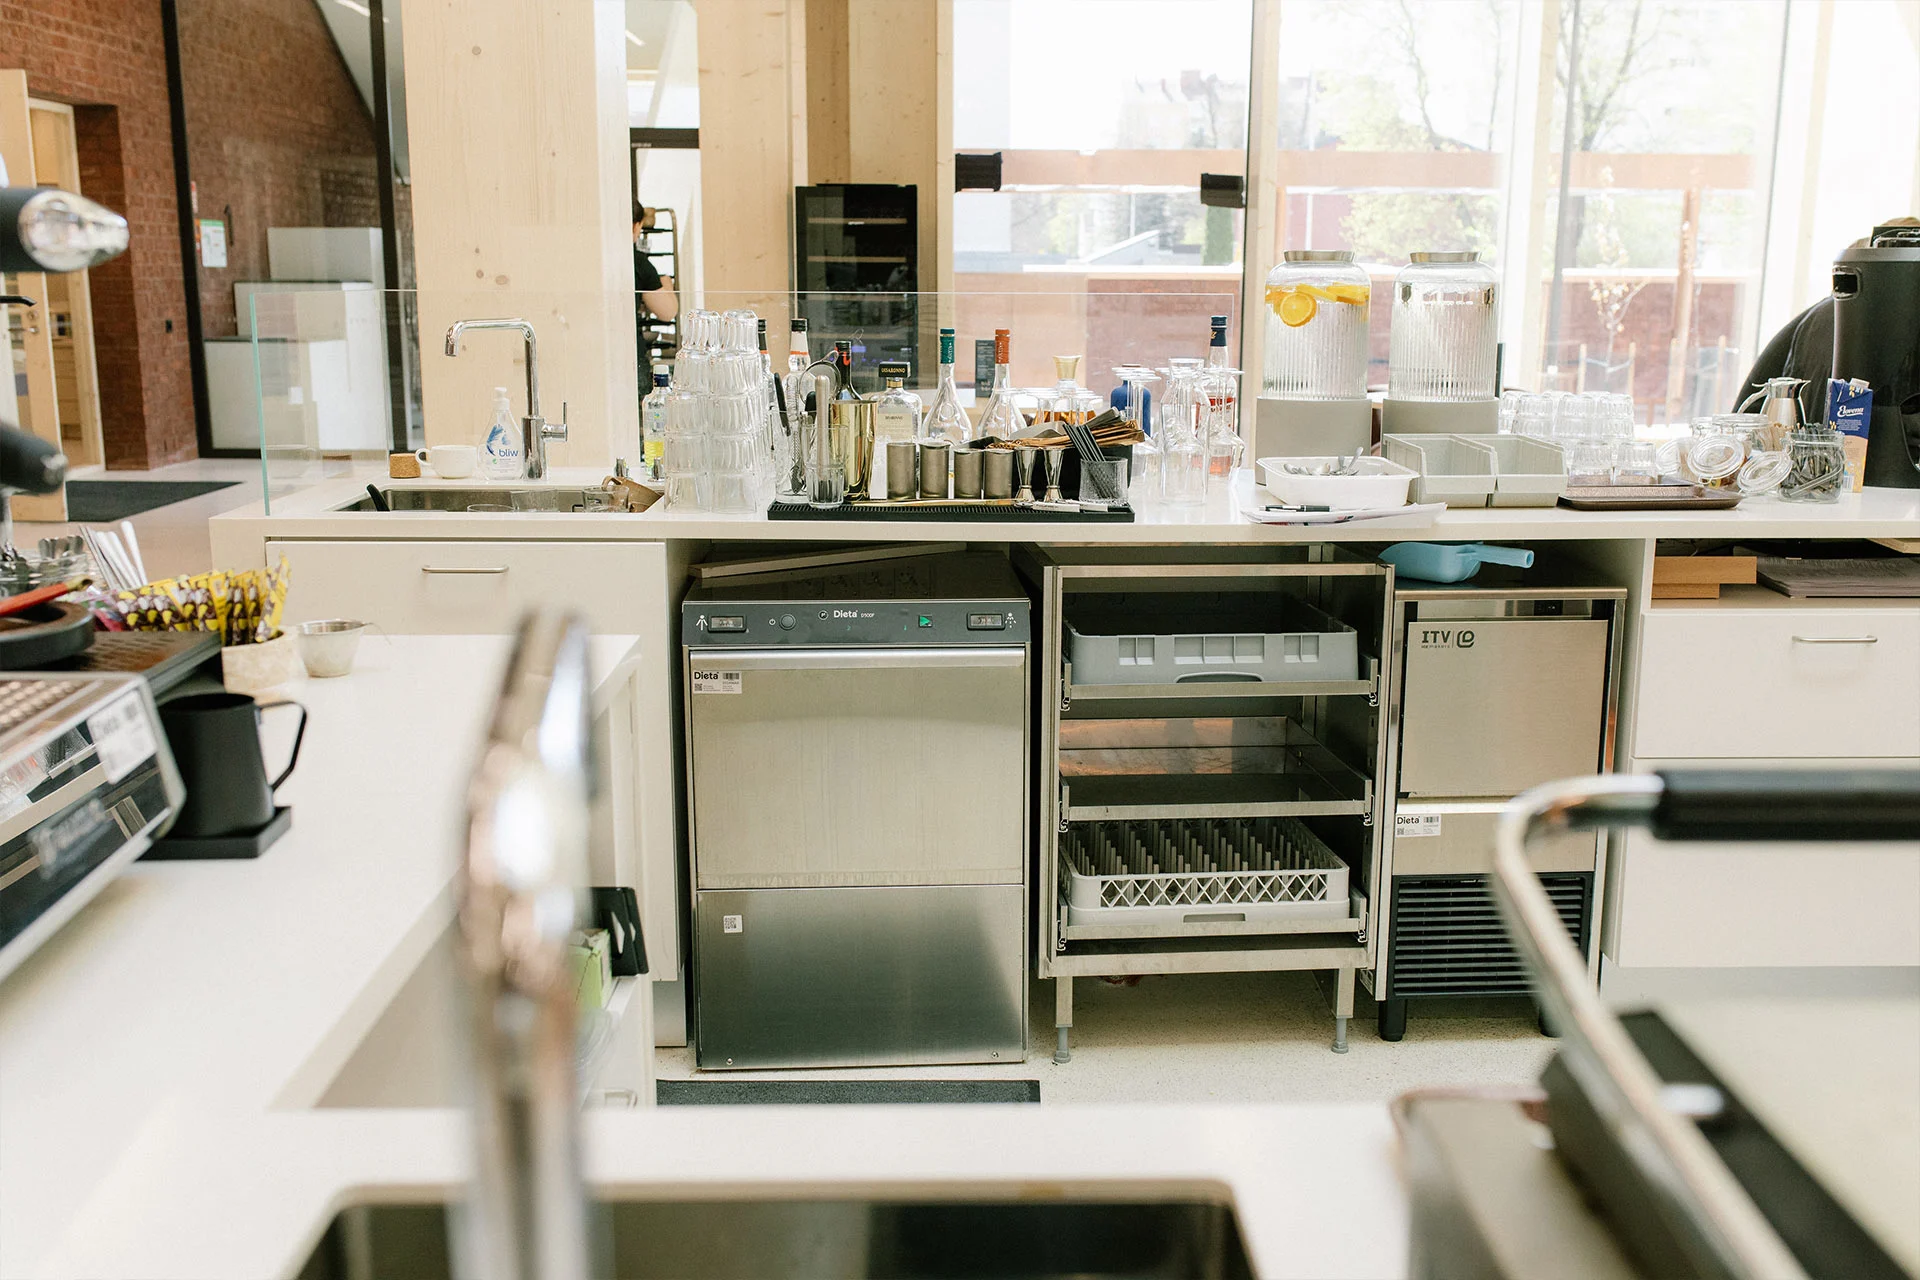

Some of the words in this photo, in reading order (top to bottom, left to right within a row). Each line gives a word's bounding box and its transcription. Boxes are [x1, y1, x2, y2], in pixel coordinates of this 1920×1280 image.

[499, 449, 518, 457] bliw
[833, 610, 858, 618] Dieta
[1421, 630, 1451, 643] ITV
[694, 671, 719, 680] Dieta
[1396, 816, 1420, 825] Dieta
